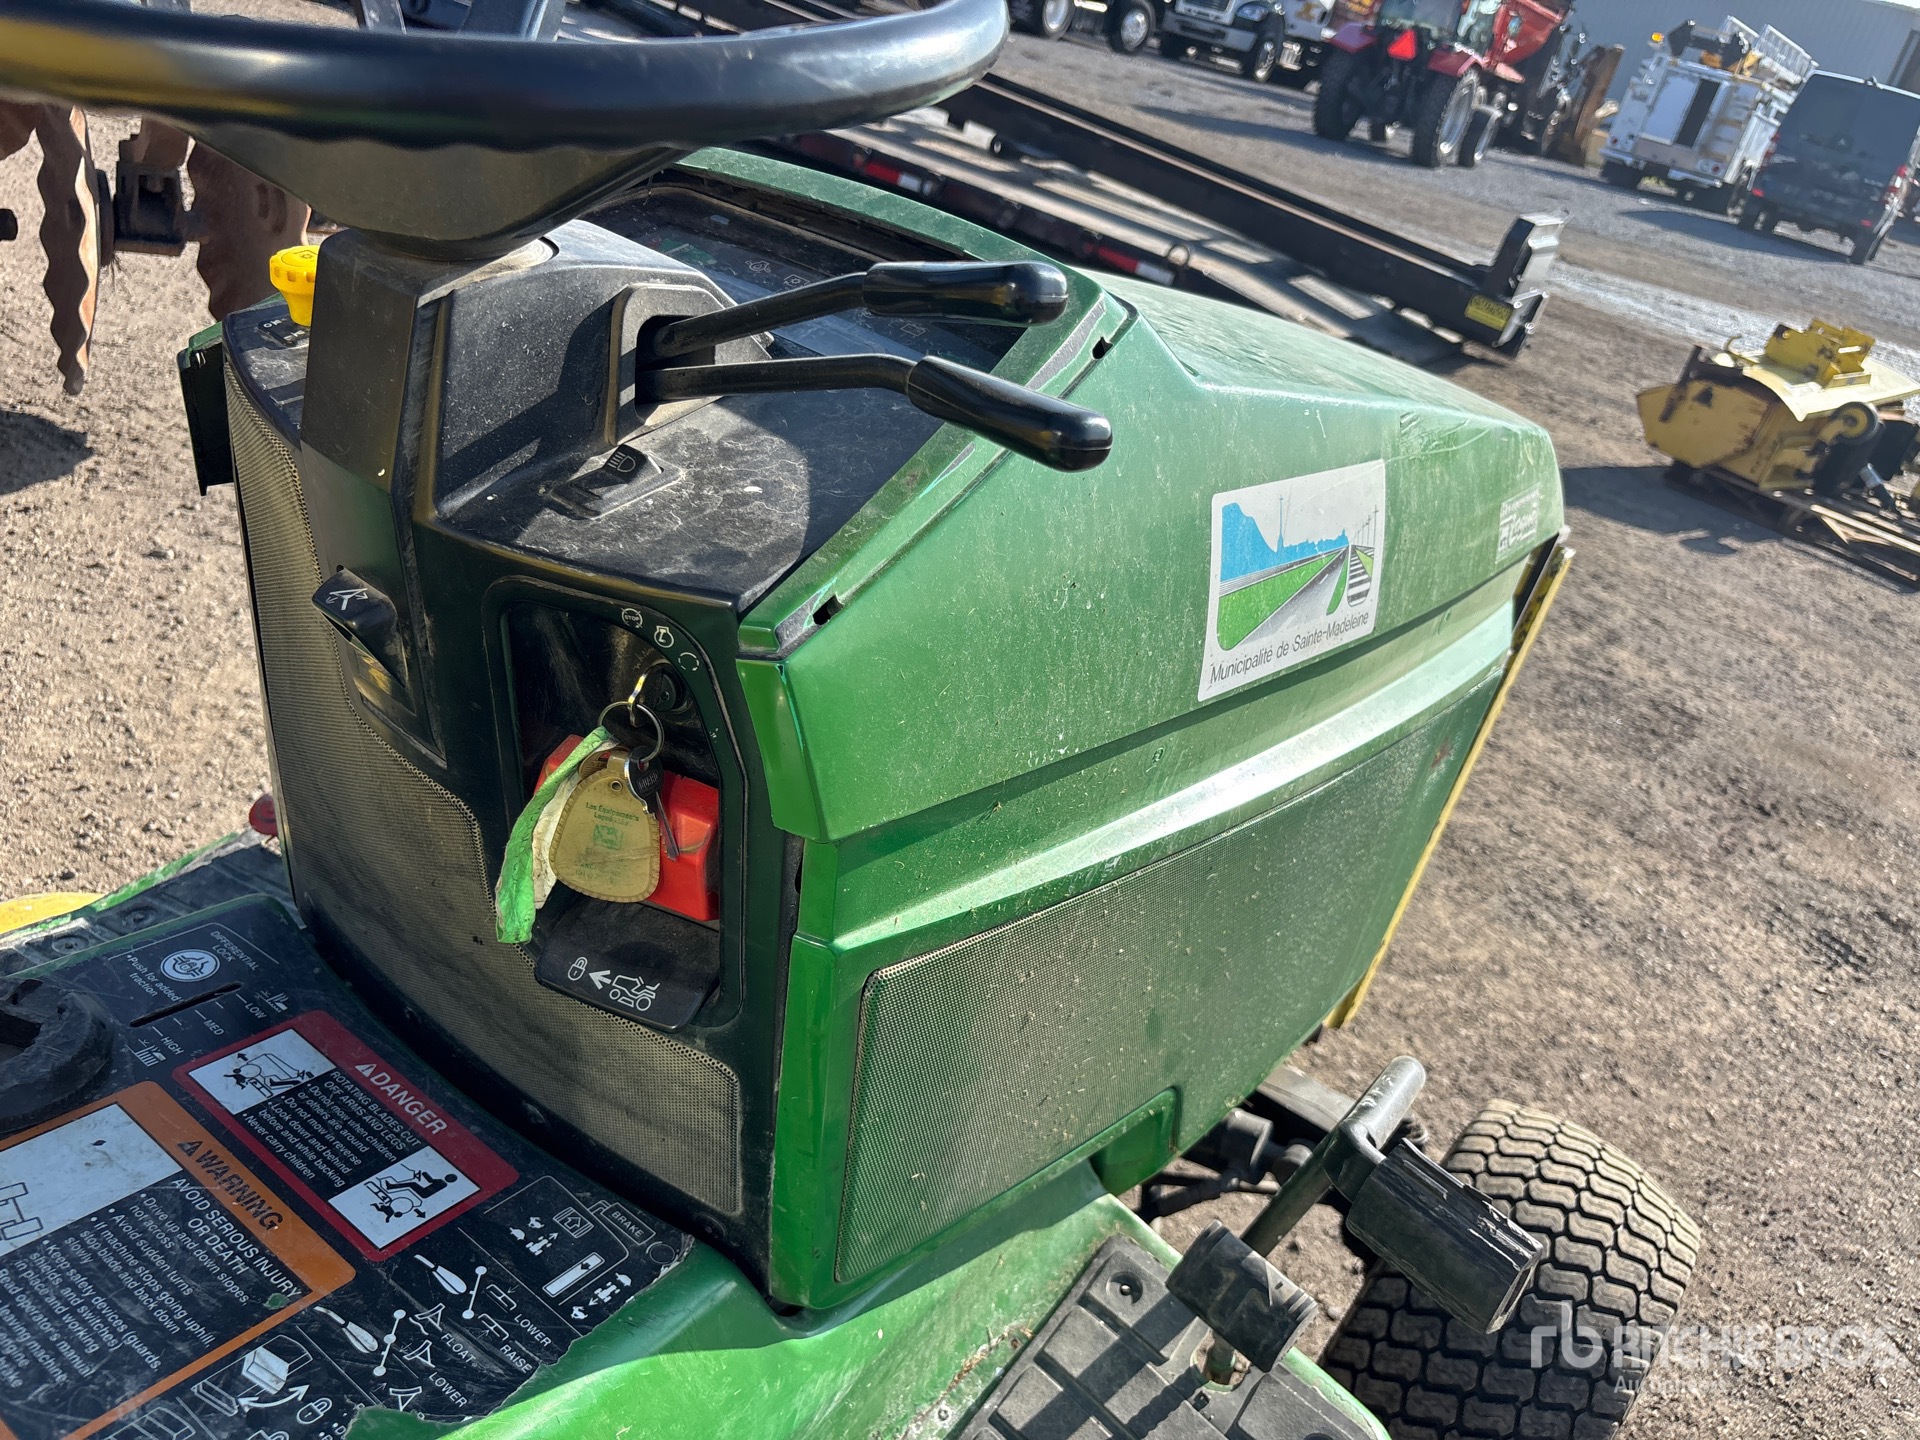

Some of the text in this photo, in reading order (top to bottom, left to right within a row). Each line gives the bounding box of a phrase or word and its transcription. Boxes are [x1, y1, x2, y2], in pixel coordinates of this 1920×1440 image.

[1210, 610, 1369, 684] Municipalité de Sainte-Madeleine
[128, 957, 181, 1001] Push for added
[210, 931, 258, 970] DIFFERENTIAL
[212, 945, 235, 961] LOCK
[130, 973, 157, 996] traction
[245, 1003, 267, 1018] LOW
[161, 1037, 184, 1054] HIGH
[204, 1020, 224, 1035] MED
[283, 1096, 361, 1165] Do not mow in reverse
[297, 1091, 370, 1152] or others are around
[308, 1085, 397, 1162] Do not mow when children
[323, 1080, 406, 1150] OFF ARMS AND LEGS
[330, 1071, 421, 1146] ROTATING BLADES CUT
[370, 1072, 447, 1134] DANGER
[245, 1116, 315, 1179] Never carry children
[259, 1109, 345, 1187] before and while backing
[271, 1103, 352, 1173] Look down and behind
[196, 1151, 283, 1231] WARNING
[64, 1237, 93, 1264] slowly
[112, 1215, 193, 1295] Avoid sudden turns
[130, 1206, 175, 1248] not across
[143, 1197, 168, 1220] Drive
[164, 1220, 181, 1233] up
[176, 1233, 199, 1249] and
[193, 1249, 220, 1273] down
[170, 1179, 301, 1297] AVOID SERIOUS INJURY
[188, 1218, 249, 1274] OR DEATH
[612, 1211, 644, 1237] BRAKE
[46, 1245, 70, 1269] Keep
[66, 1269, 96, 1296] safety
[91, 1297, 127, 1332] devices
[80, 1231, 180, 1334] stop blade and back down
[93, 1221, 109, 1231] If
[101, 1230, 139, 1266] machine
[135, 1266, 162, 1291] stops
[156, 1292, 188, 1319] going
[0, 1269, 96, 1377] Read operator's manual
[13, 1258, 100, 1353] in place and working
[60, 1288, 84, 1306] and
[77, 1306, 126, 1352] switches)
[514, 1314, 551, 1346] LOWER
[441, 1333, 476, 1362] FLOAT
[500, 1345, 532, 1373] RAISE
[429, 1372, 467, 1407] LOWER
